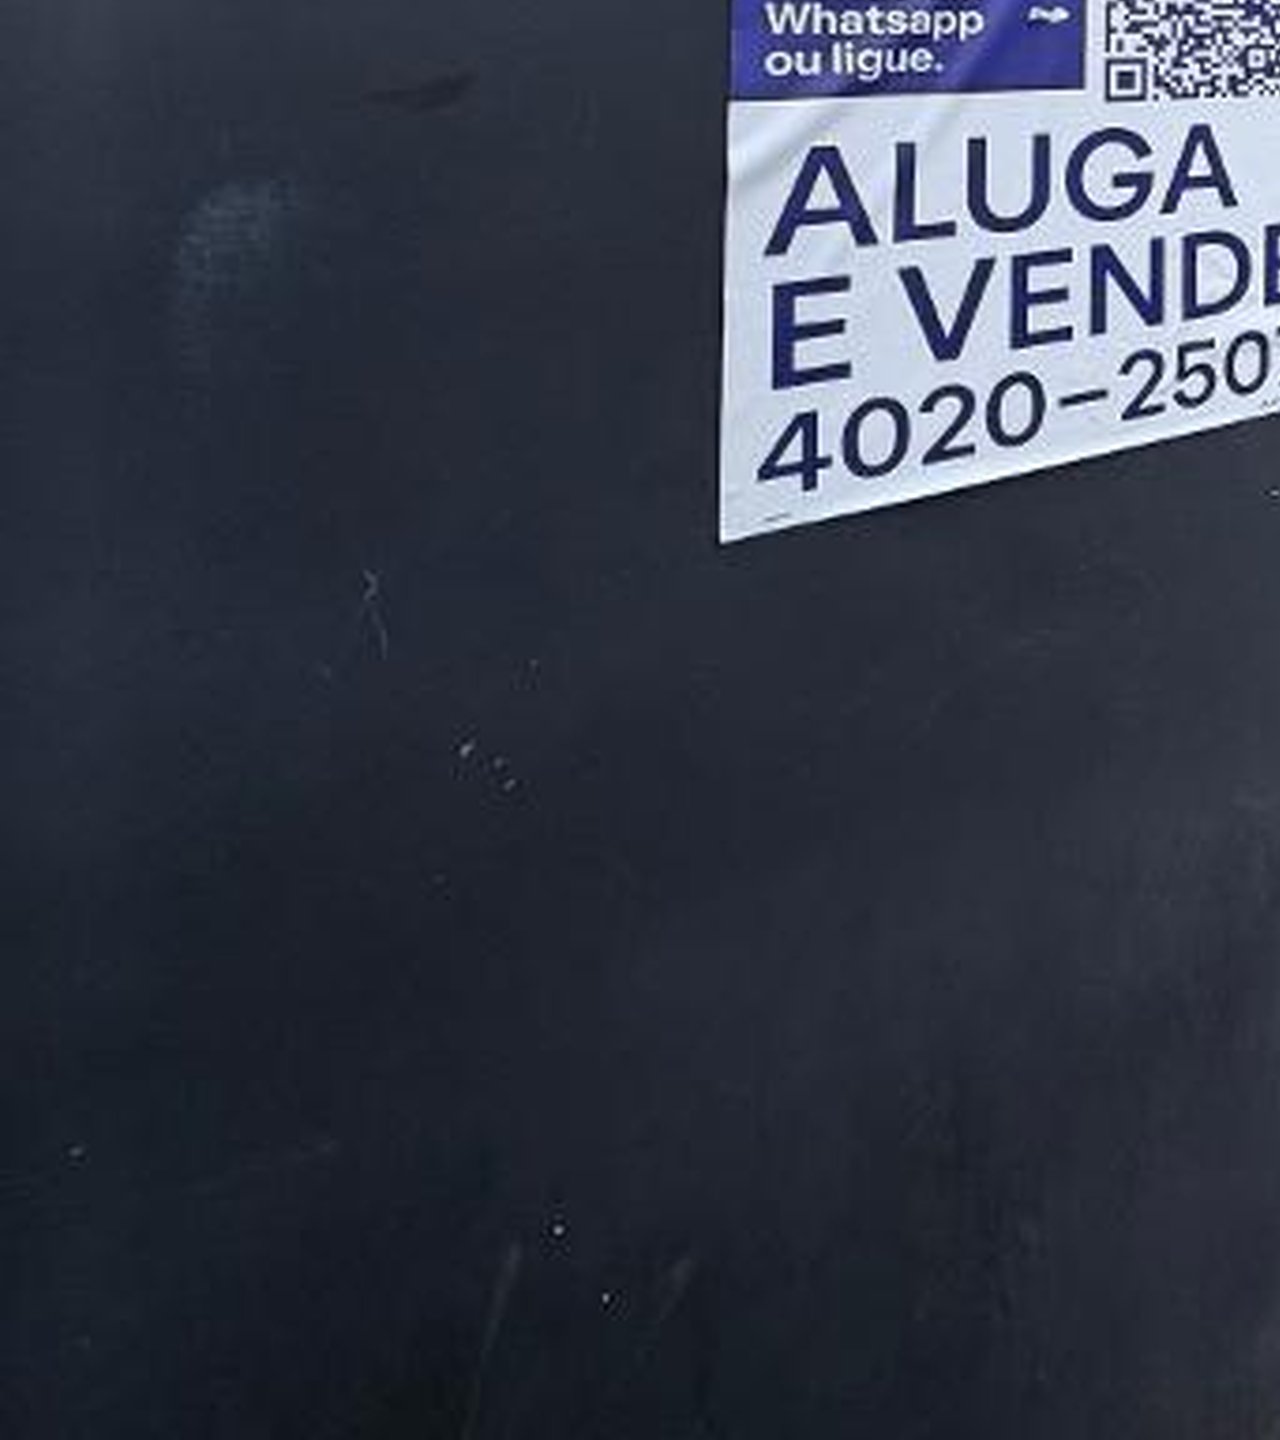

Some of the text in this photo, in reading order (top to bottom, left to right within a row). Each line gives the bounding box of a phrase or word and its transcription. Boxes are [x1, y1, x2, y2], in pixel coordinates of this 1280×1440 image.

[765, 3, 985, 42] Whatsapp
[765, 42, 944, 81] ou ligue.
[764, 123, 1239, 257] ALUGA
[771, 275, 852, 391] E
